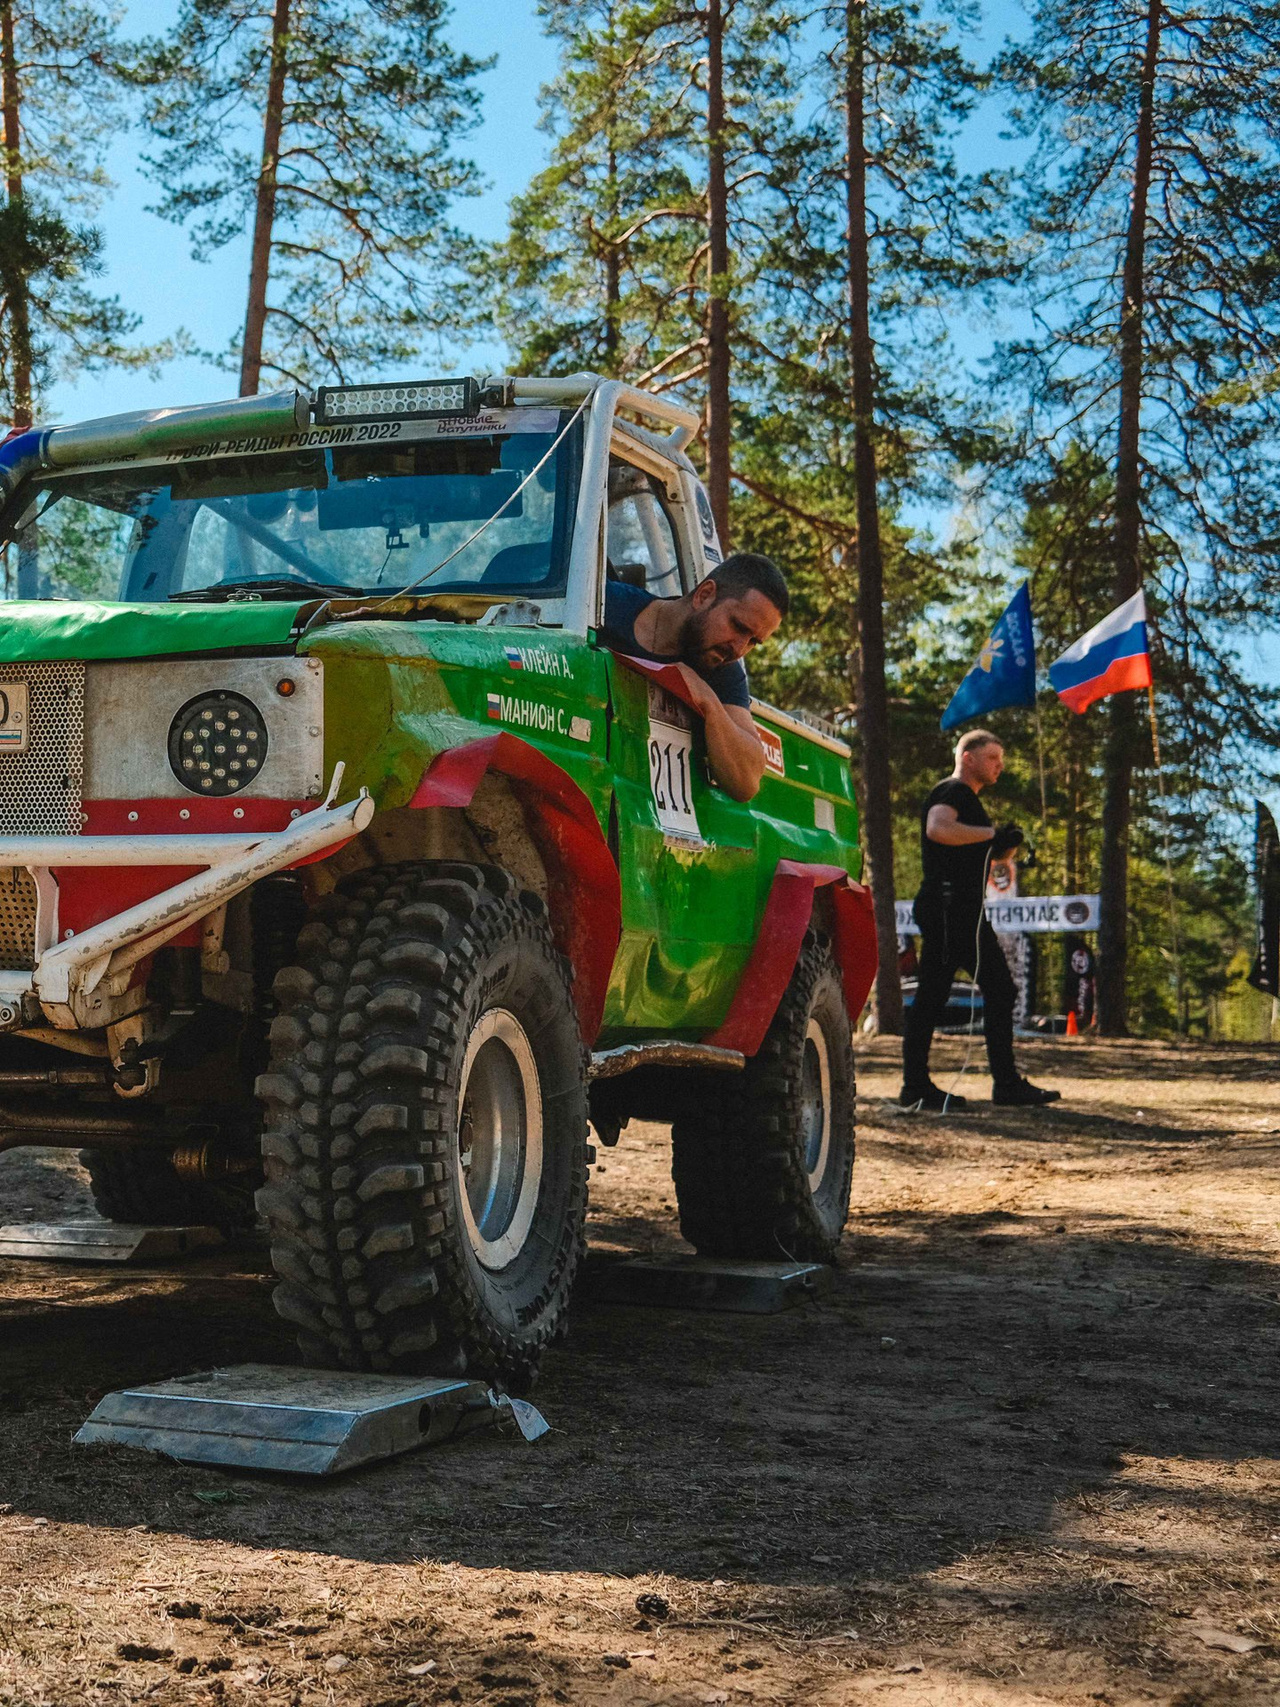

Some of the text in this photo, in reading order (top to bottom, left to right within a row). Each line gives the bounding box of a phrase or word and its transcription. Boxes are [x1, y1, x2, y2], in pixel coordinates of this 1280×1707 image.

[437, 420, 507, 433] Ватутинки
[517, 644, 574, 679] КЛЕЙН А.
[557, 708, 568, 735] С.
[650, 740, 691, 815] 211
